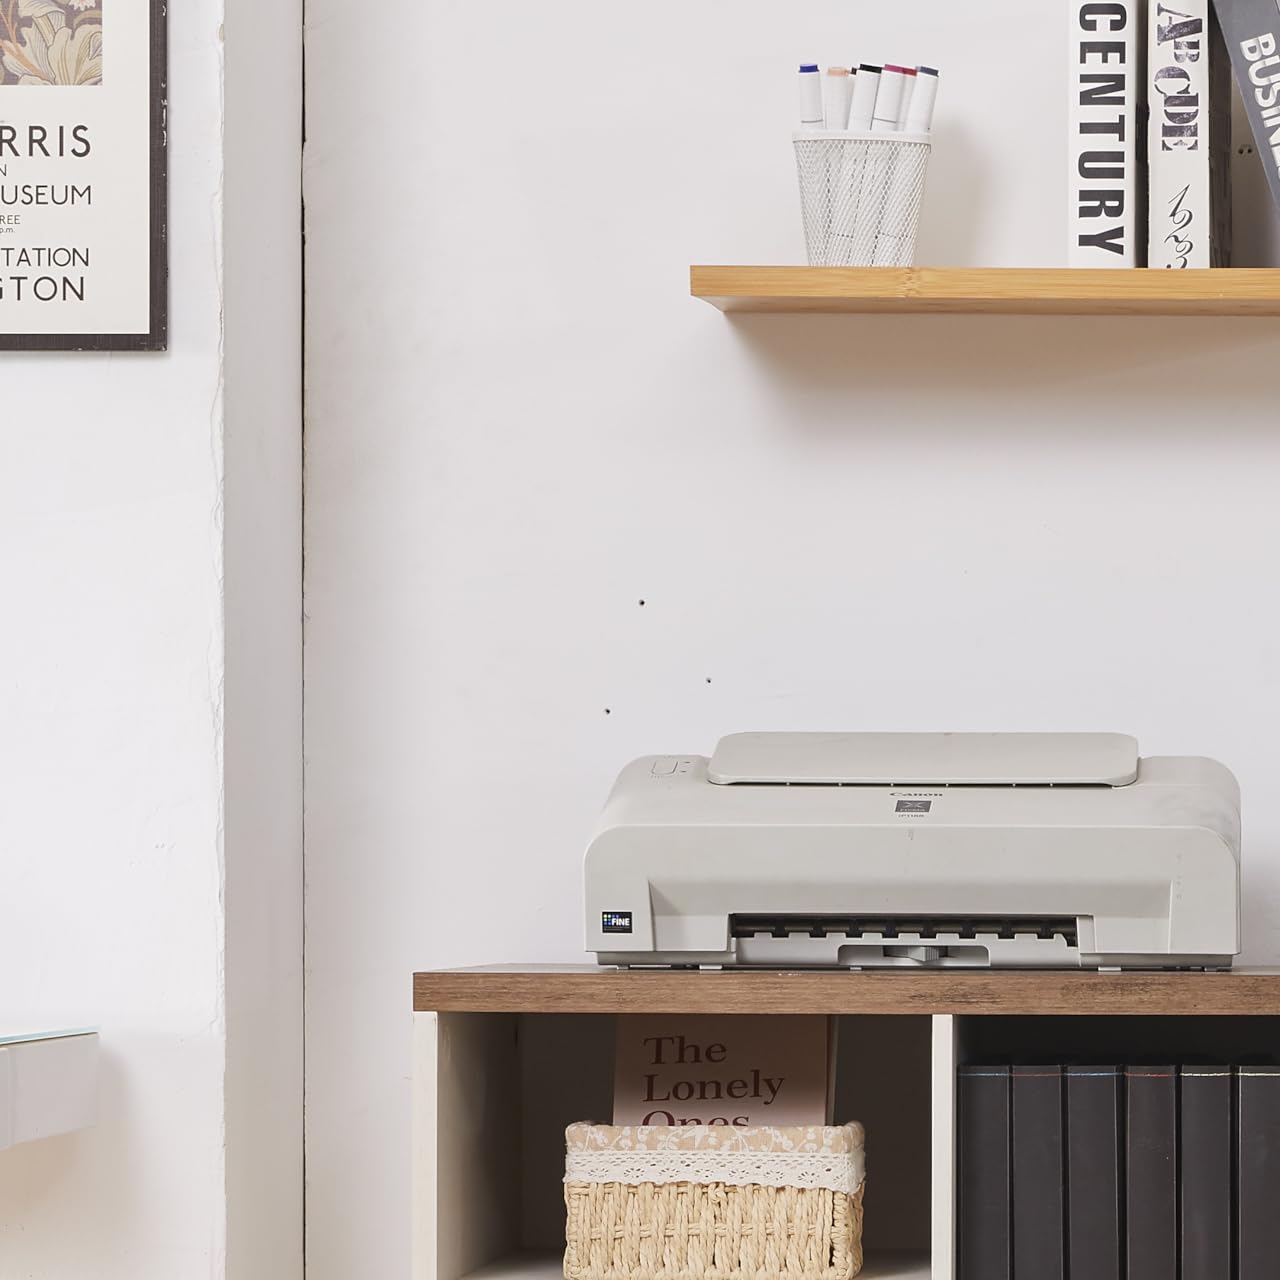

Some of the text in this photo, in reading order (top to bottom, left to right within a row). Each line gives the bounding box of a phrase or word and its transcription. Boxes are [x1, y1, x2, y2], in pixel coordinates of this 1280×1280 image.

[1078, 3, 1127, 256] CENTURY
[1, 184, 92, 206] USEUM
[0, 247, 89, 267] TATION
[0, 276, 84, 301] TON
[643, 1035, 728, 1065] The
[642, 1069, 785, 1105] Lonely
